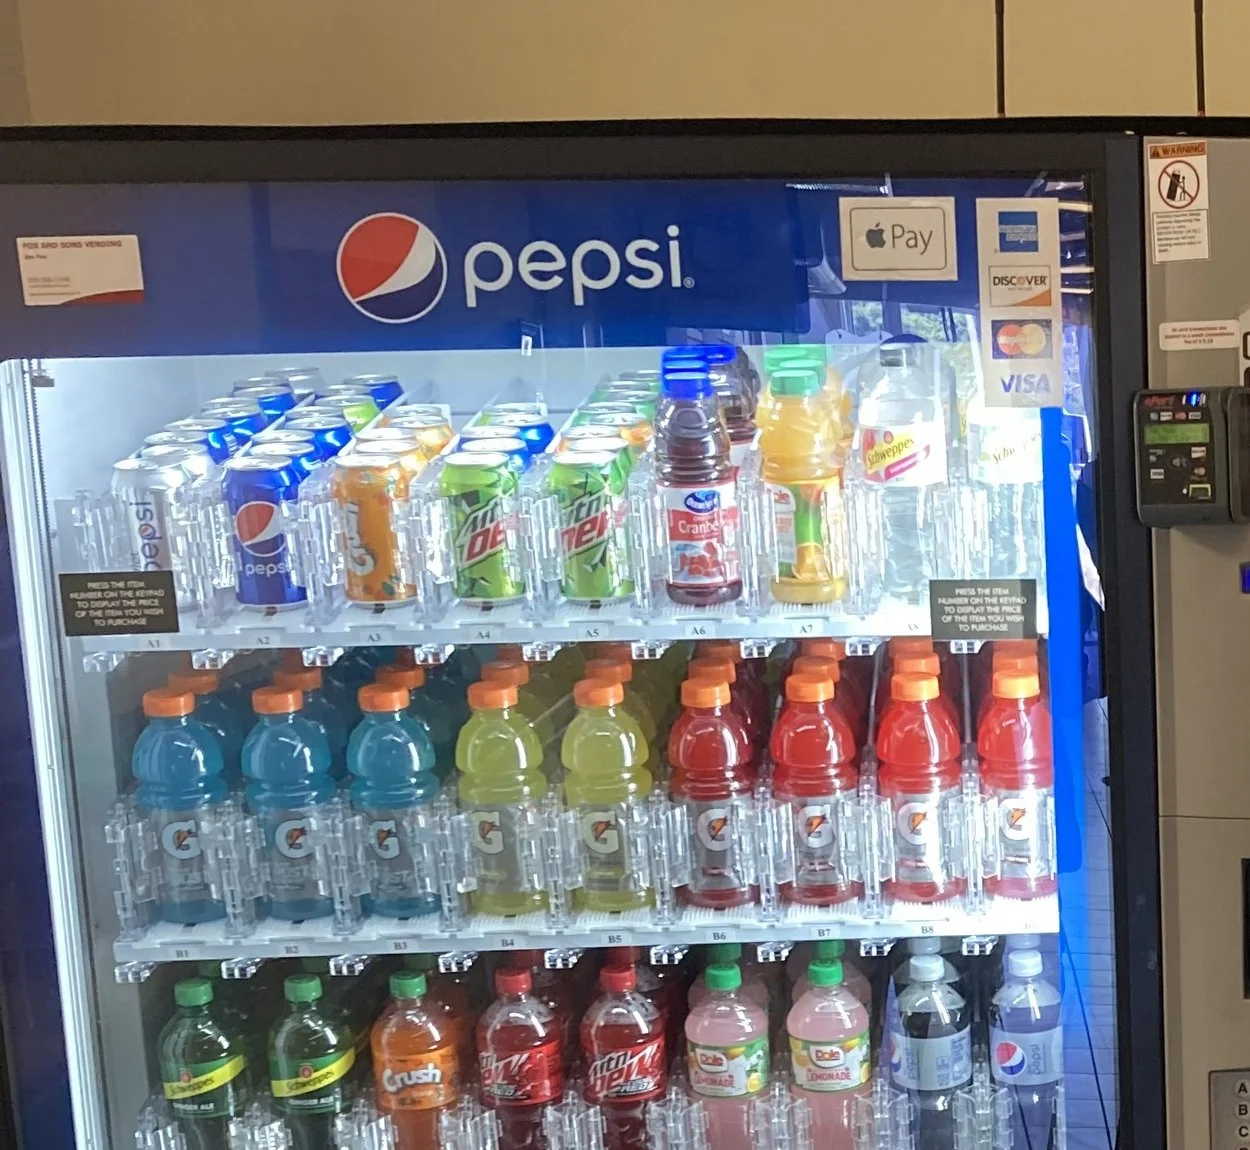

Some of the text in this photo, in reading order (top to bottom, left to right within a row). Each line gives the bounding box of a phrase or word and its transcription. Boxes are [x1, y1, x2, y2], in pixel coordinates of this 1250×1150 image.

[1160, 144, 1205, 157] WARNING
[892, 224, 933, 256] Pay
[464, 225, 682, 307] pepsi
[992, 276, 1048, 287] DISCOVER
[1000, 374, 1050, 393] VISA
[955, 588, 976, 596] PRESS
[977, 588, 990, 596] THE
[938, 597, 1026, 605] NUMBER ON THE KEYPAD
[944, 606, 1022, 614] TO DISPLAY THE PRICE
[941, 615, 1024, 623] OF THE ITEM YOU WISH
[691, 627, 706, 635] A6
[799, 625, 813, 634] A7
[958, 624, 1008, 632] TO PURCHASE
[476, 630, 490, 639] A4
[255, 636, 269, 645] A2
[921, 925, 934, 934] B8
[713, 931, 726, 940] B6
[501, 938, 514, 947] B4
[285, 946, 298, 955] B2
[815, 1050, 841, 1061] Dole
[382, 1062, 442, 1092] Crush
[807, 1069, 852, 1082] LEMONADE
[695, 1073, 736, 1088] LEMONADE
[1238, 1082, 1248, 1094] A
[1238, 1104, 1248, 1115] B
[1239, 1126, 1248, 1138] C
